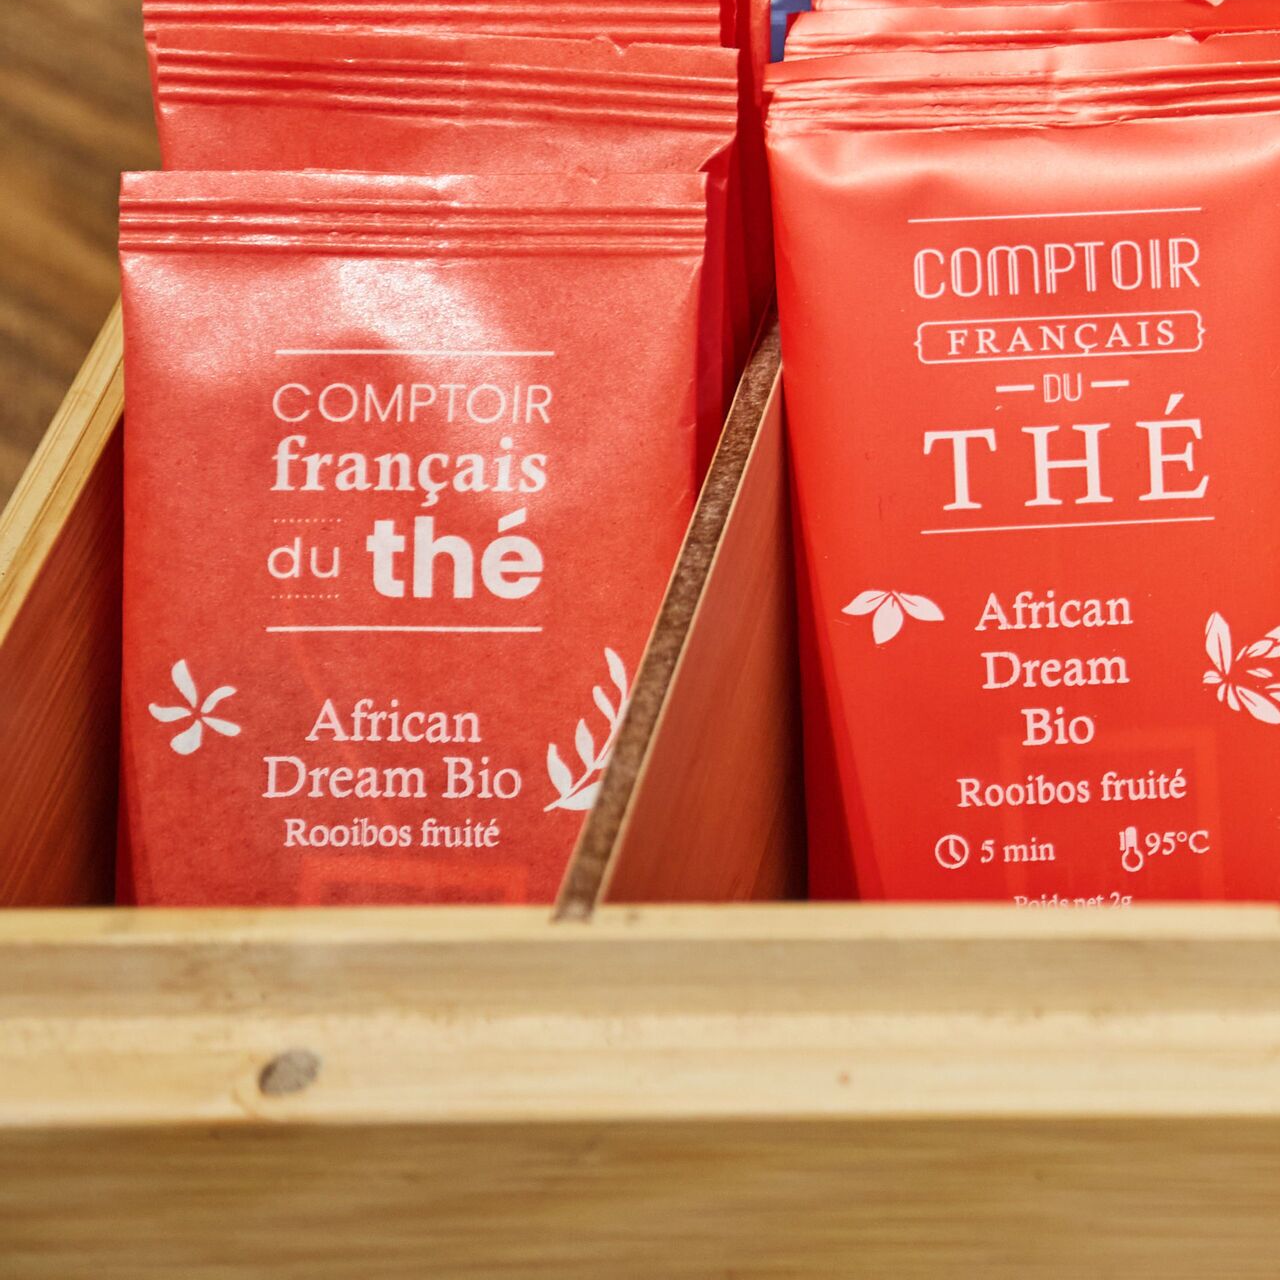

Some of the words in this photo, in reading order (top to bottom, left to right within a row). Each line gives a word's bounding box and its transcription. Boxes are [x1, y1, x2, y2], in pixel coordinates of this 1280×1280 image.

[912, 236, 1202, 301] COMPTOIR
[946, 317, 1176, 356] FRANÇAIS
[271, 381, 553, 425] COMPTOIR
[1042, 372, 1084, 404] DU
[270, 434, 547, 507] français
[923, 393, 1210, 511] THÉ
[267, 536, 341, 580] du
[366, 507, 544, 600] thé
[975, 590, 1134, 633] African
[981, 649, 1131, 690] Dream
[305, 698, 481, 744] African
[1021, 706, 1097, 748] Bio
[262, 754, 427, 799] Dream
[441, 755, 522, 800] Bio
[957, 775, 1091, 808] Rooibos
[1099, 768, 1188, 802] fruité
[284, 818, 412, 849] Rooibos
[420, 818, 500, 849] fruité
[980, 840, 994, 863] 5
[1003, 838, 1056, 863] min
[1145, 830, 1210, 856] 95°C
